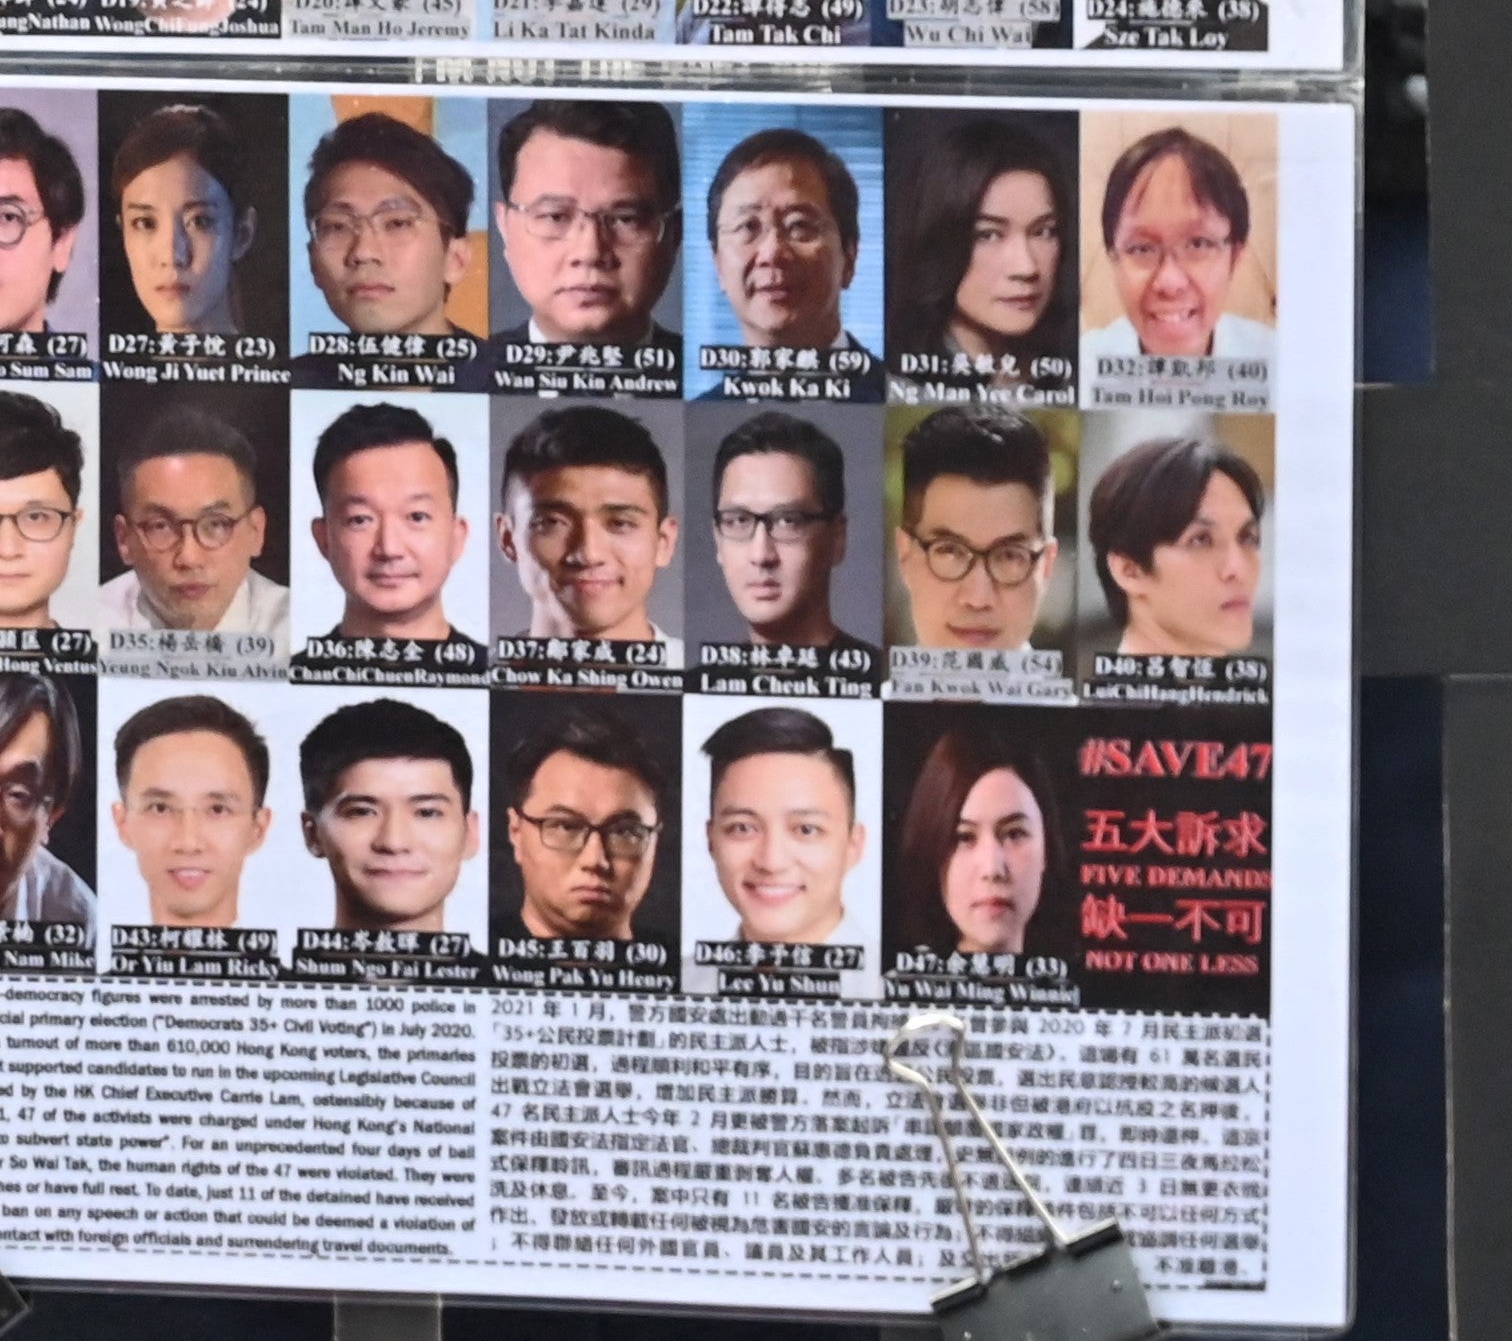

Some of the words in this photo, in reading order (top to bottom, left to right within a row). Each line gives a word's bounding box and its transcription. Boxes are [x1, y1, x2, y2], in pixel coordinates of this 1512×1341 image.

[291, 19, 326, 36] Tam
[334, 20, 370, 36] Man
[378, 20, 403, 36] Ho
[407, 20, 469, 38] Jeremy
[494, 20, 513, 39] Li
[521, 21, 549, 39] Ka
[556, 21, 587, 40] Tat
[595, 21, 656, 40] Kinda
[711, 24, 753, 44] Tam
[760, 24, 798, 44] Tak
[803, 25, 841, 44] Chi
[905, 25, 941, 43] Wu
[948, 25, 984, 43] Chi
[991, 25, 1033, 44] Wai
[47, 335, 87, 358] (27)
[236, 337, 276, 360] (23)
[437, 338, 477, 360] (25)
[635, 347, 675, 370] (51)
[829, 350, 871, 374] (59)
[104, 361, 158, 383] Wong
[161, 363, 179, 381] Ji
[183, 364, 225, 382] Yuet
[231, 364, 292, 383] Prince
[338, 363, 367, 386] Ng
[373, 364, 409, 383] Kin
[415, 365, 456, 385] Wai
[724, 377, 785, 397] Kwok
[789, 378, 819, 397] Ka
[825, 379, 851, 398] Ki
[237, 636, 275, 657] (39)
[434, 641, 476, 666] (48)
[626, 643, 666, 666] (24)
[829, 648, 871, 673] (43)
[491, 667, 541, 685] Chow
[546, 668, 573, 686] Ka
[577, 669, 627, 689] Shing
[631, 671, 683, 689] Owen
[701, 675, 747, 693] Lam
[752, 675, 820, 695] Cheuk
[825, 677, 872, 699] Ting
[1079, 738, 1273, 780] #SAVE47
[1083, 808, 1268, 857] 五大訴求
[1080, 864, 1141, 886] FIVE
[1147, 866, 1272, 889] DEMANDS
[1081, 893, 1266, 944] 缺一不可
[44, 924, 85, 947] (32)
[238, 930, 277, 952] (49)
[430, 933, 471, 957] (27)
[4, 950, 45, 967] Nam
[50, 951, 96, 968] Mike
[626, 942, 667, 966] (30)
[1085, 951, 1136, 971] NOT
[1141, 952, 1193, 973] ONE
[1198, 954, 1259, 975] LESS
[112, 956, 136, 972] Or
[140, 957, 172, 973] Yiu
[179, 958, 221, 975] Lam
[227, 958, 279, 979] Ricky
[493, 965, 546, 986] Wong
[551, 967, 586, 985] Pak
[589, 968, 613, 986] Yu
[619, 969, 674, 990] Henry
[92, 991, 141, 1005] figures
[148, 993, 182, 1005] were
[190, 994, 250, 1007] arrested
[257, 995, 273, 1009] by
[281, 997, 318, 1009] more
[325, 996, 357, 1010] than
[366, 998, 404, 1012] 1000
[411, 1000, 456, 1015] police
[462, 1000, 476, 1013] in
[399, 1023, 425, 1038] July
[431, 1023, 475, 1039] 2020.
